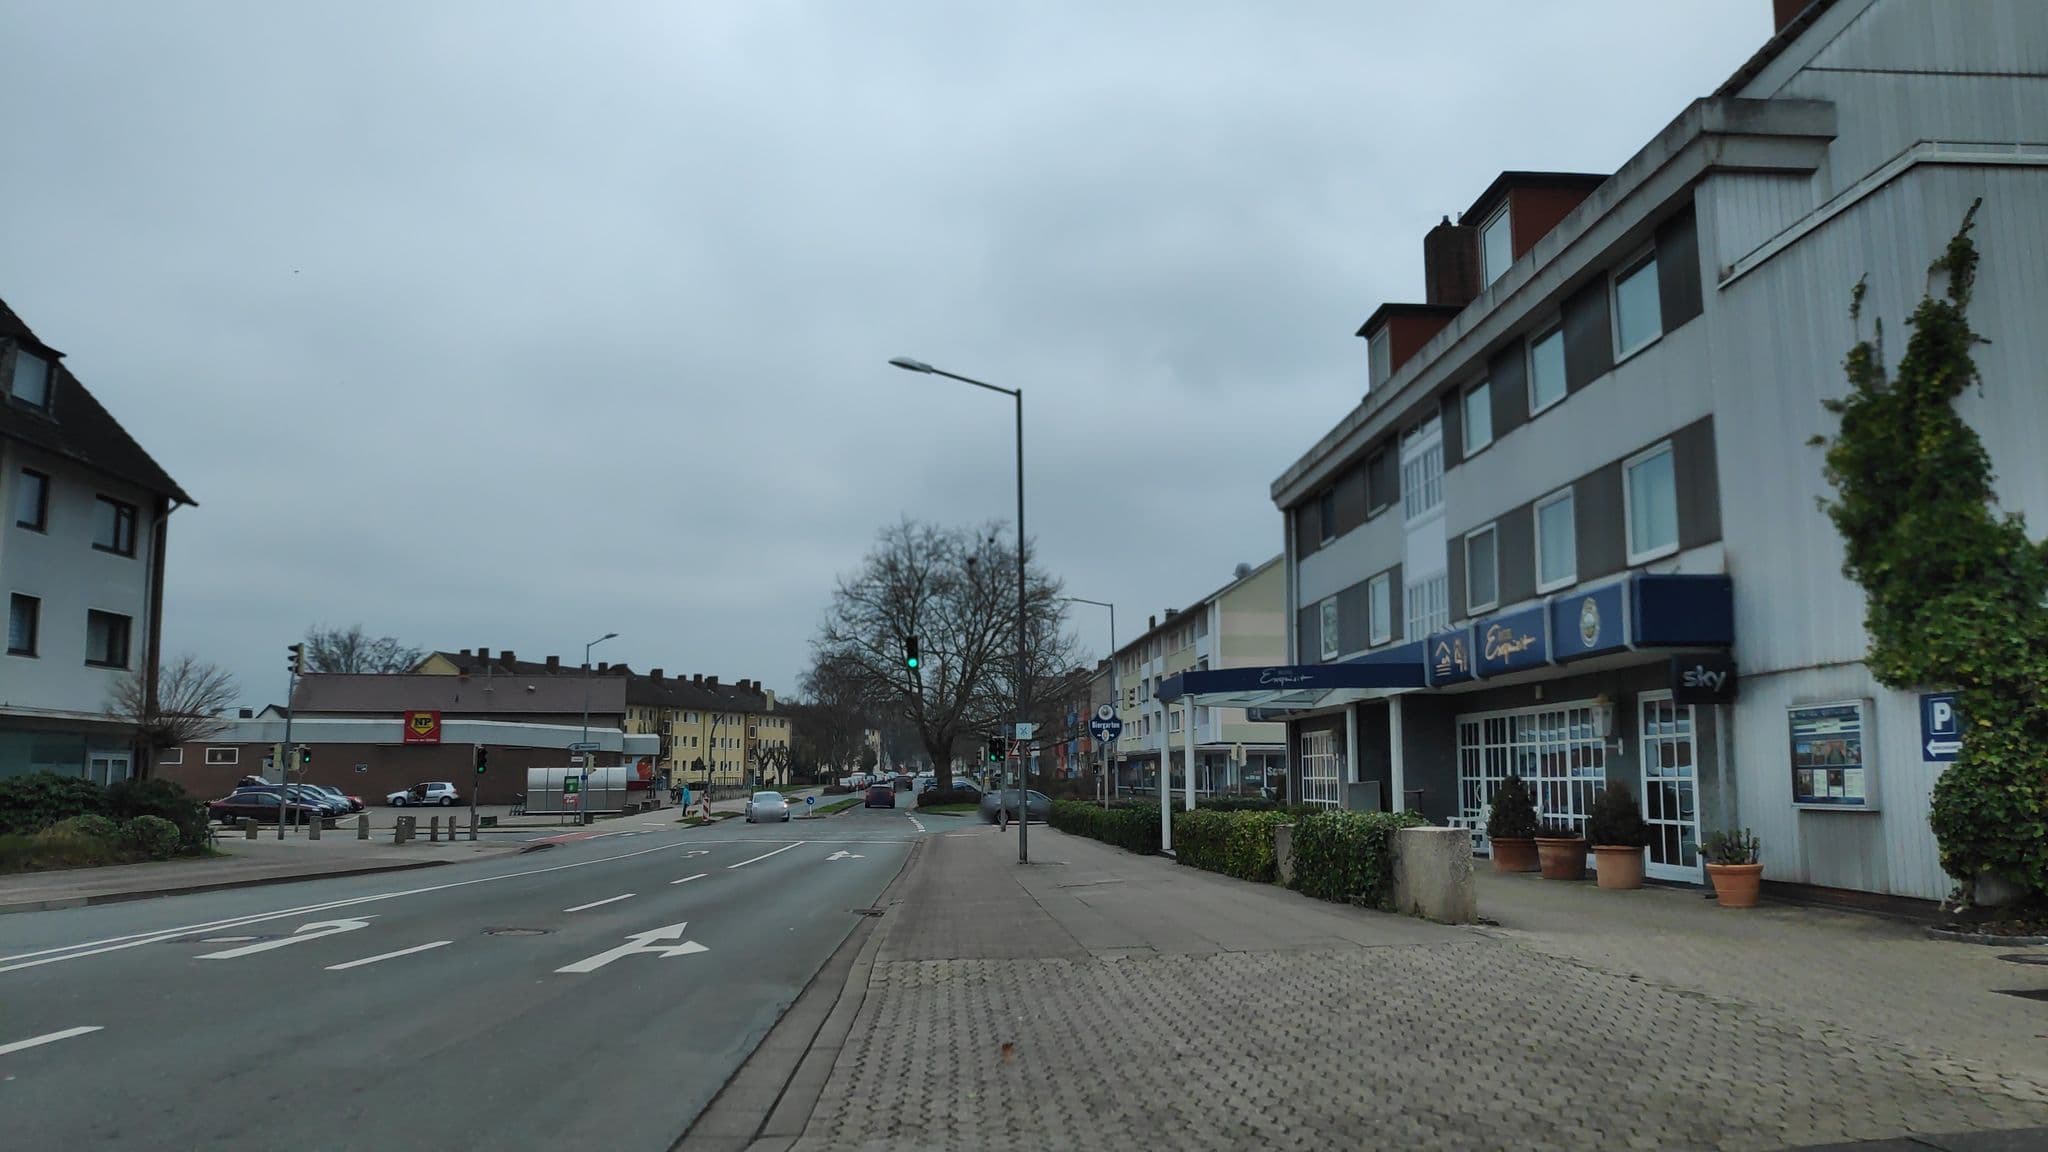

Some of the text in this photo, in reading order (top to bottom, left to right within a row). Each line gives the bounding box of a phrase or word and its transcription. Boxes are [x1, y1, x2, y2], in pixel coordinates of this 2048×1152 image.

[1683, 665, 1726, 692] sky
[414, 718, 432, 726] NP
[1933, 702, 1951, 730] P
[1092, 721, 1120, 729] Biergarten
